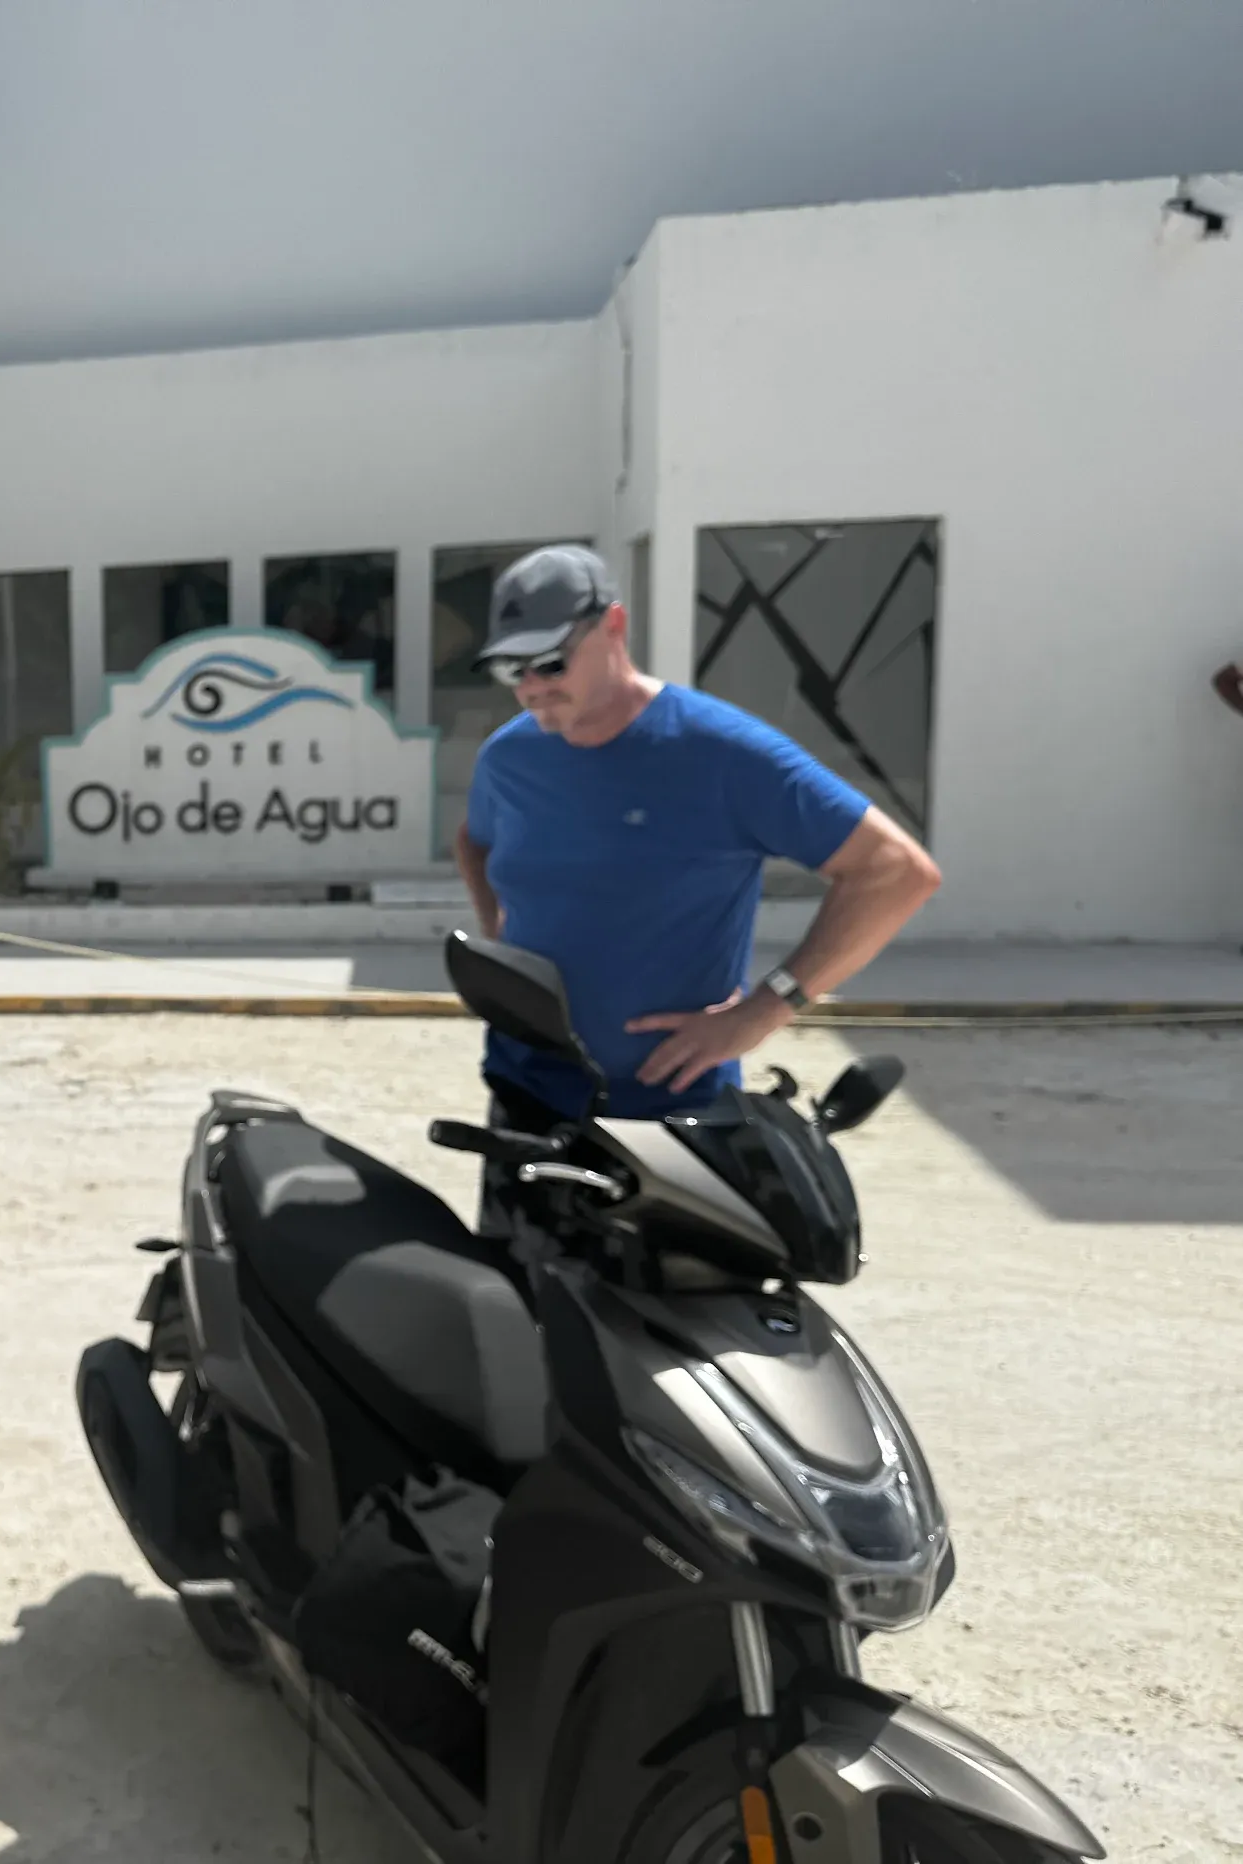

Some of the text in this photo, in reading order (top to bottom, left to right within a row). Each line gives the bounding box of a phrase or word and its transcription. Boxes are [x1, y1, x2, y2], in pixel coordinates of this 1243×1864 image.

[144, 741, 324, 768] HOTEL
[68, 779, 398, 844] Ojo de Agua
